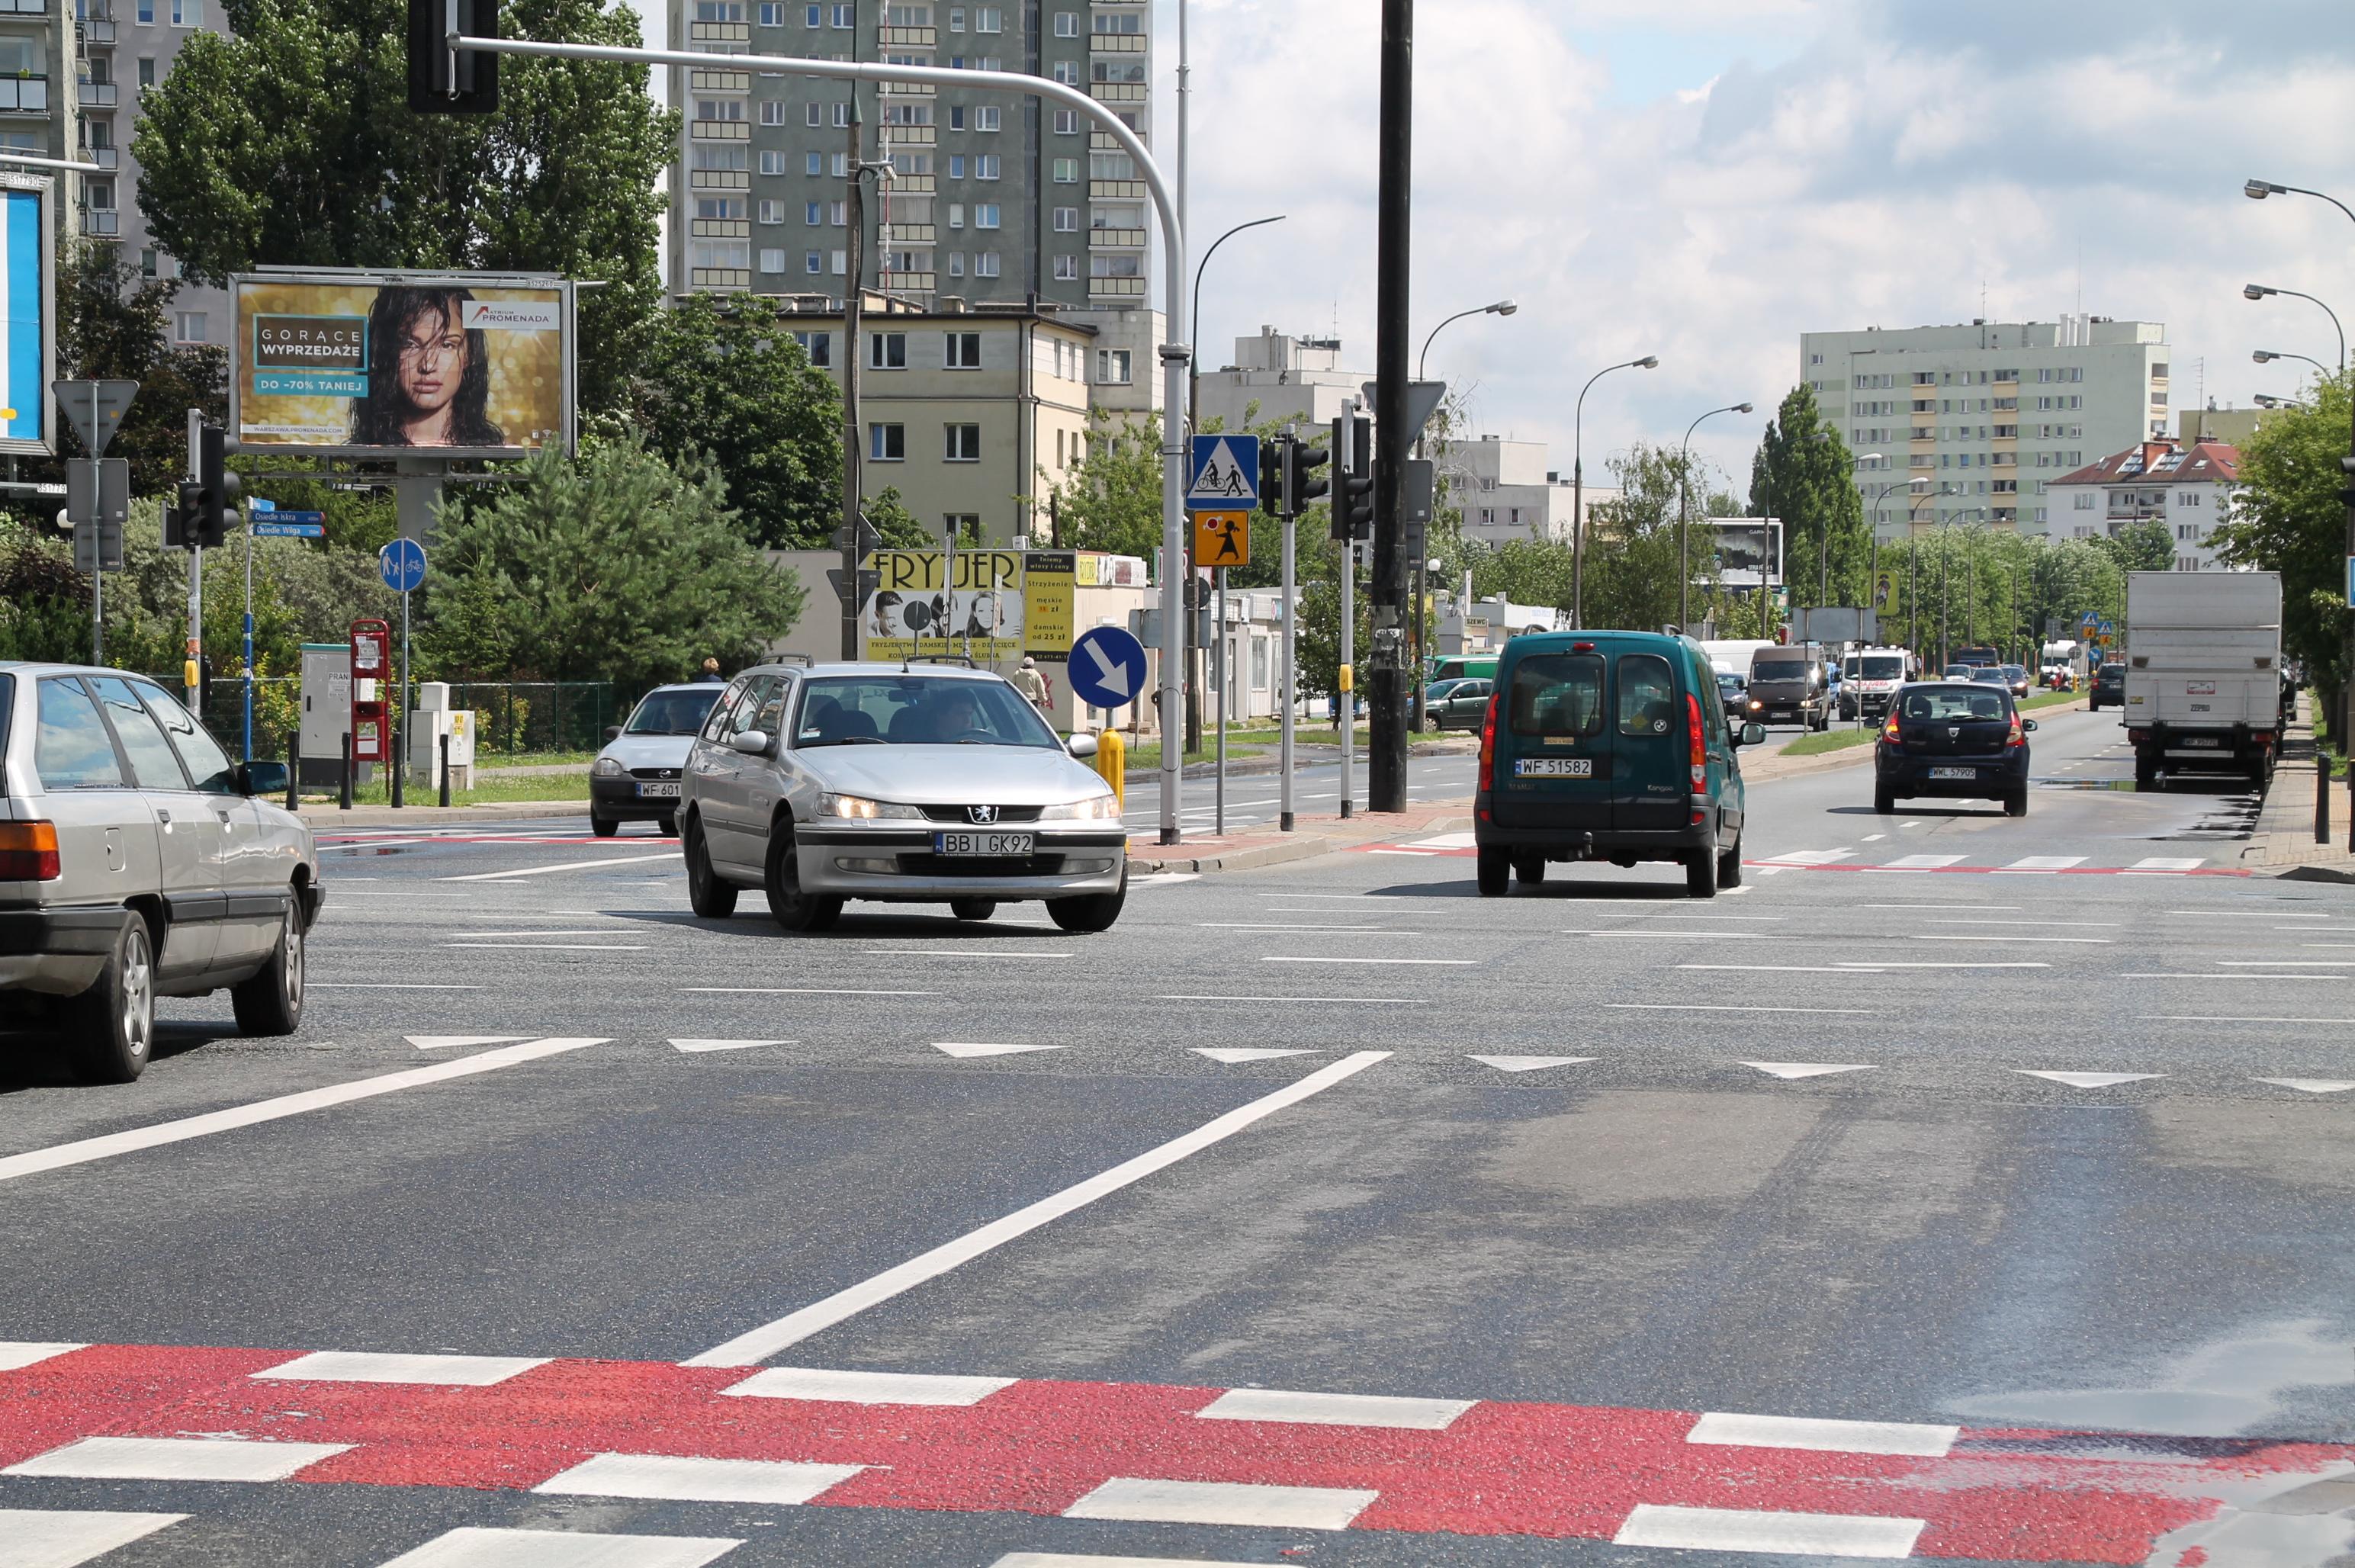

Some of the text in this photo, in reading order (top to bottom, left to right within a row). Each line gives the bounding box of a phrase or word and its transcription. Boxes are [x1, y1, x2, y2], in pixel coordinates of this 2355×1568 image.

[482, 314, 550, 323] PROMENADA
[262, 329, 361, 342] GORĄCE
[262, 344, 361, 357] WYPRZEDAŻE
[261, 380, 362, 391] DO -70% TANIEJ
[282, 527, 300, 536] Wilga
[1523, 760, 1589, 774] WF 51582
[1933, 768, 1975, 776] WWL 57905
[642, 784, 679, 795] WF 601
[946, 835, 1031, 852] BBI GK92
